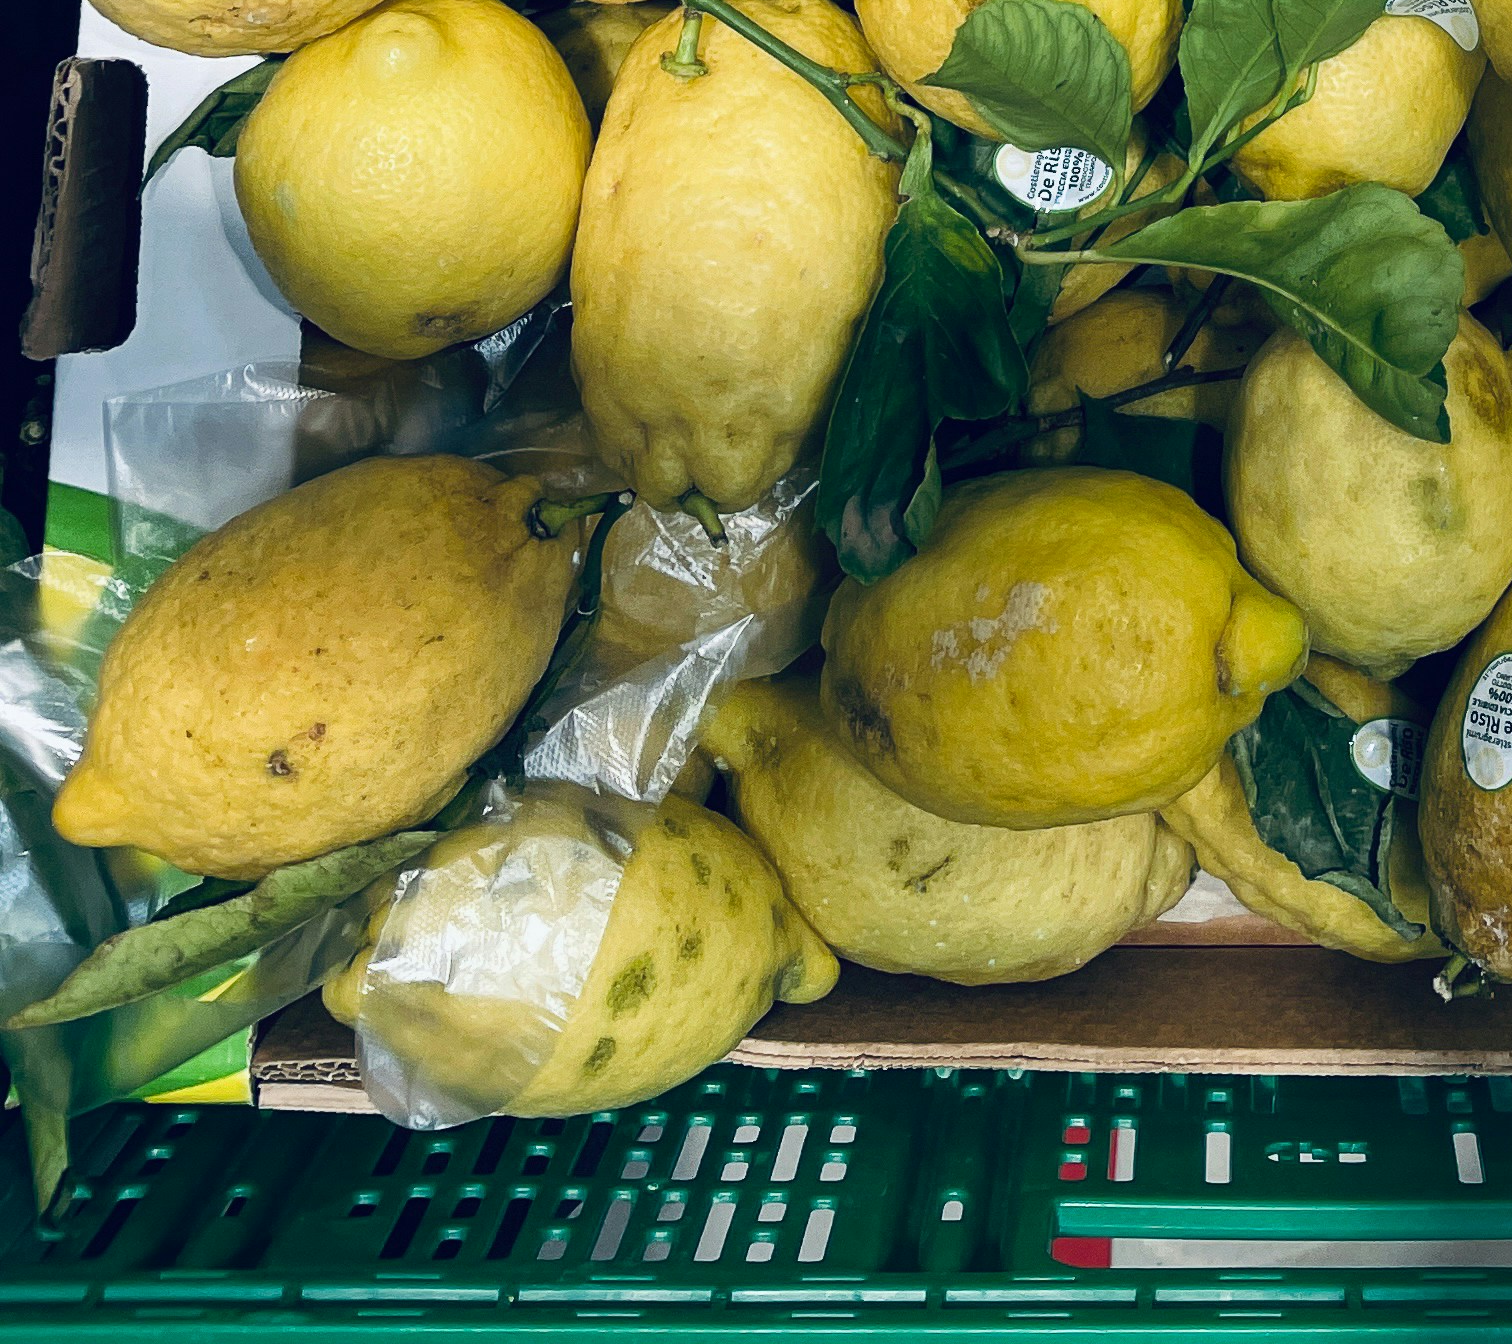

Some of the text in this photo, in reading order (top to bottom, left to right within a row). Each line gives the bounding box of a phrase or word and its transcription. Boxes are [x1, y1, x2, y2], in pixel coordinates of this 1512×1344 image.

[1026, 150, 1045, 200] Costierag
[1038, 147, 1062, 202] De Ris
[1068, 151, 1085, 190] 100%
[1470, 710, 1500, 735] Riso
